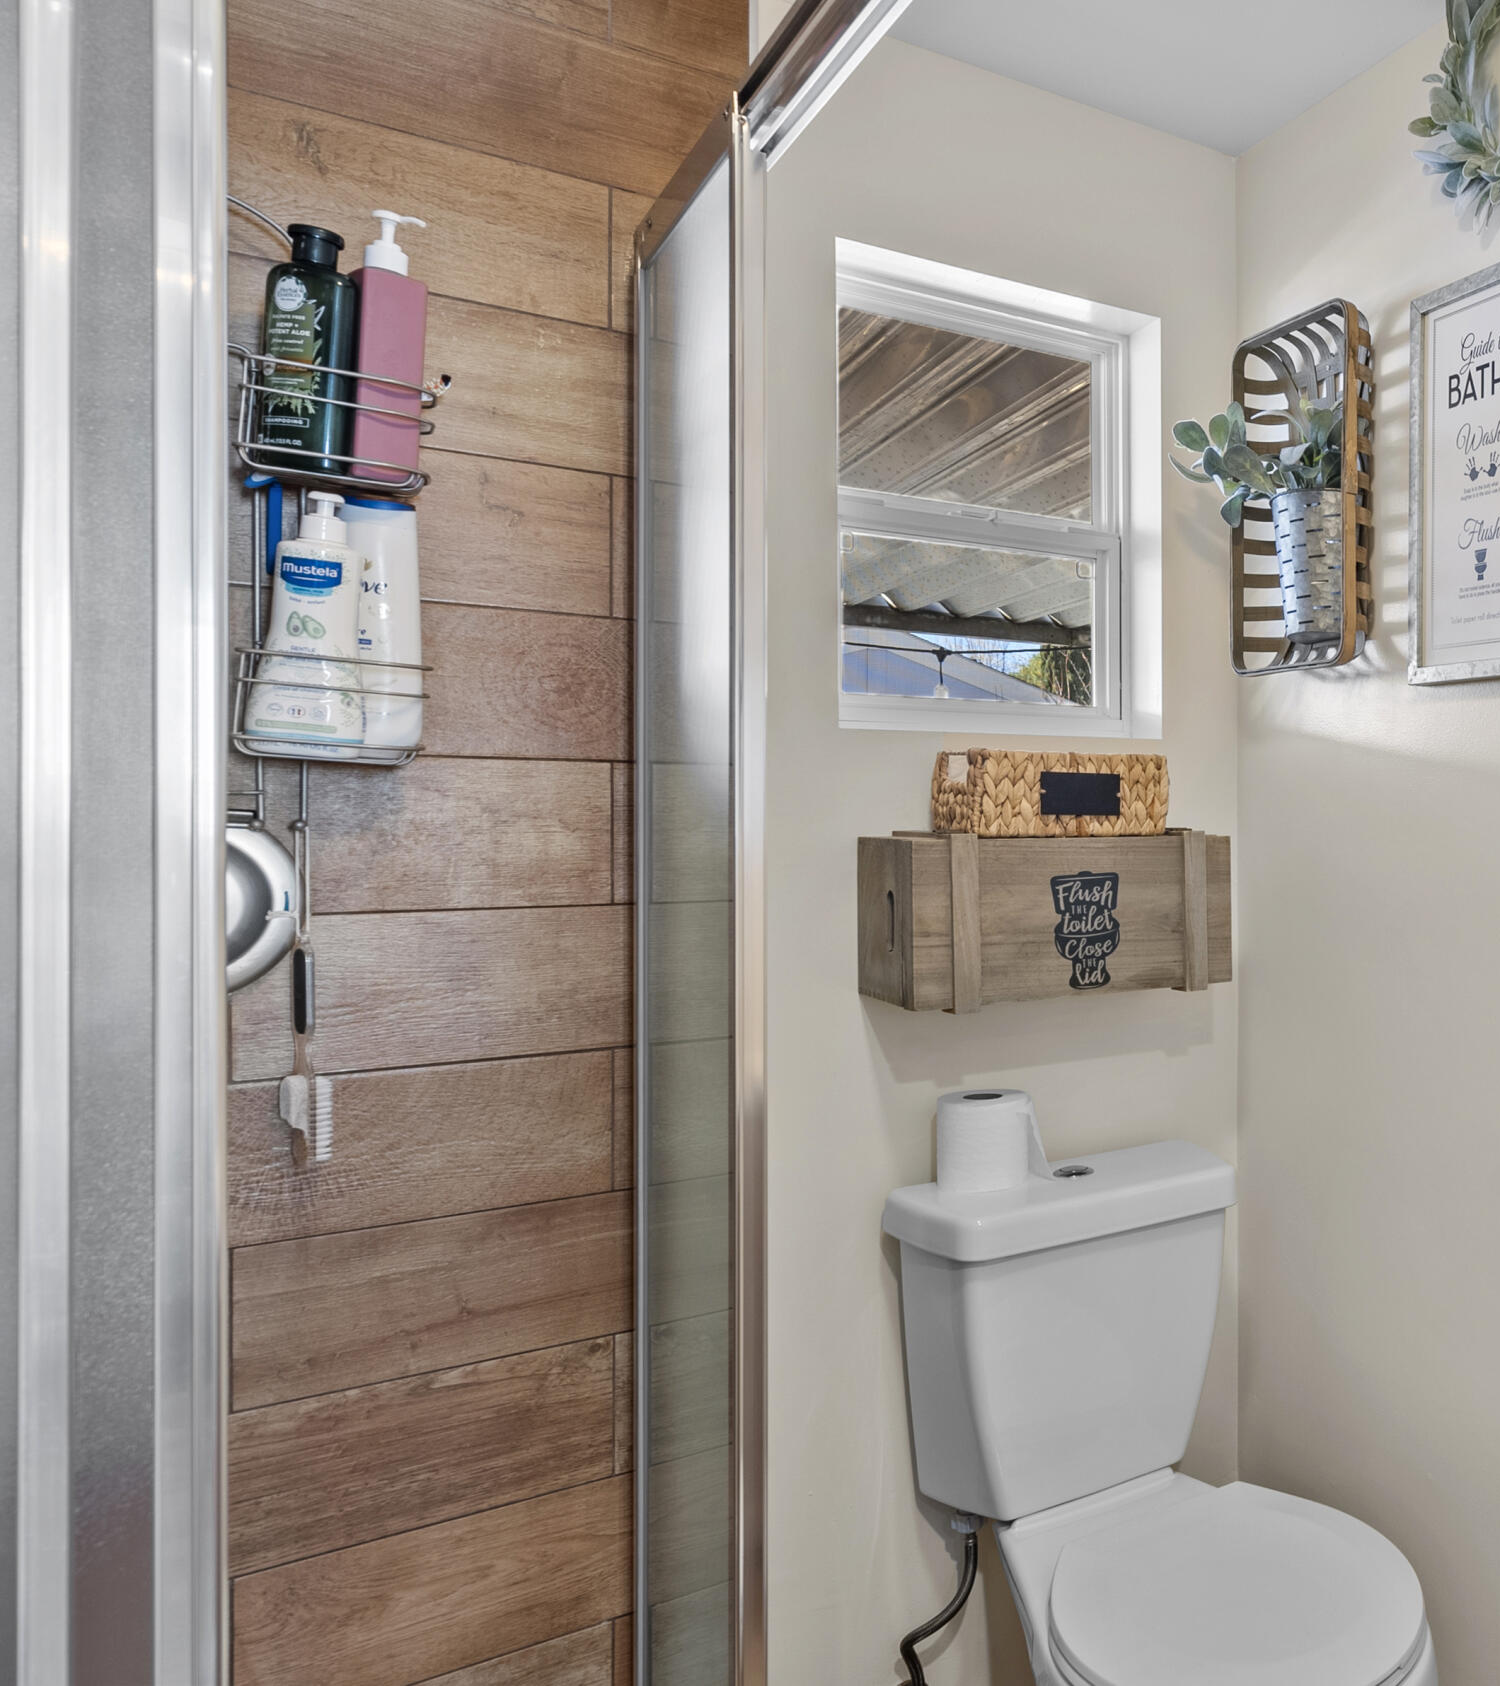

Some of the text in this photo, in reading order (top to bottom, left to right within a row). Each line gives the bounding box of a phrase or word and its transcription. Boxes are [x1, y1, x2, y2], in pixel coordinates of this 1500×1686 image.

[1460, 332, 1495, 375] Guide
[1056, 881, 1115, 911] Flush
[1070, 903, 1088, 914] THE
[1062, 906, 1113, 933] toilet
[1063, 936, 1113, 961] Close
[1082, 958, 1097, 968] THE
